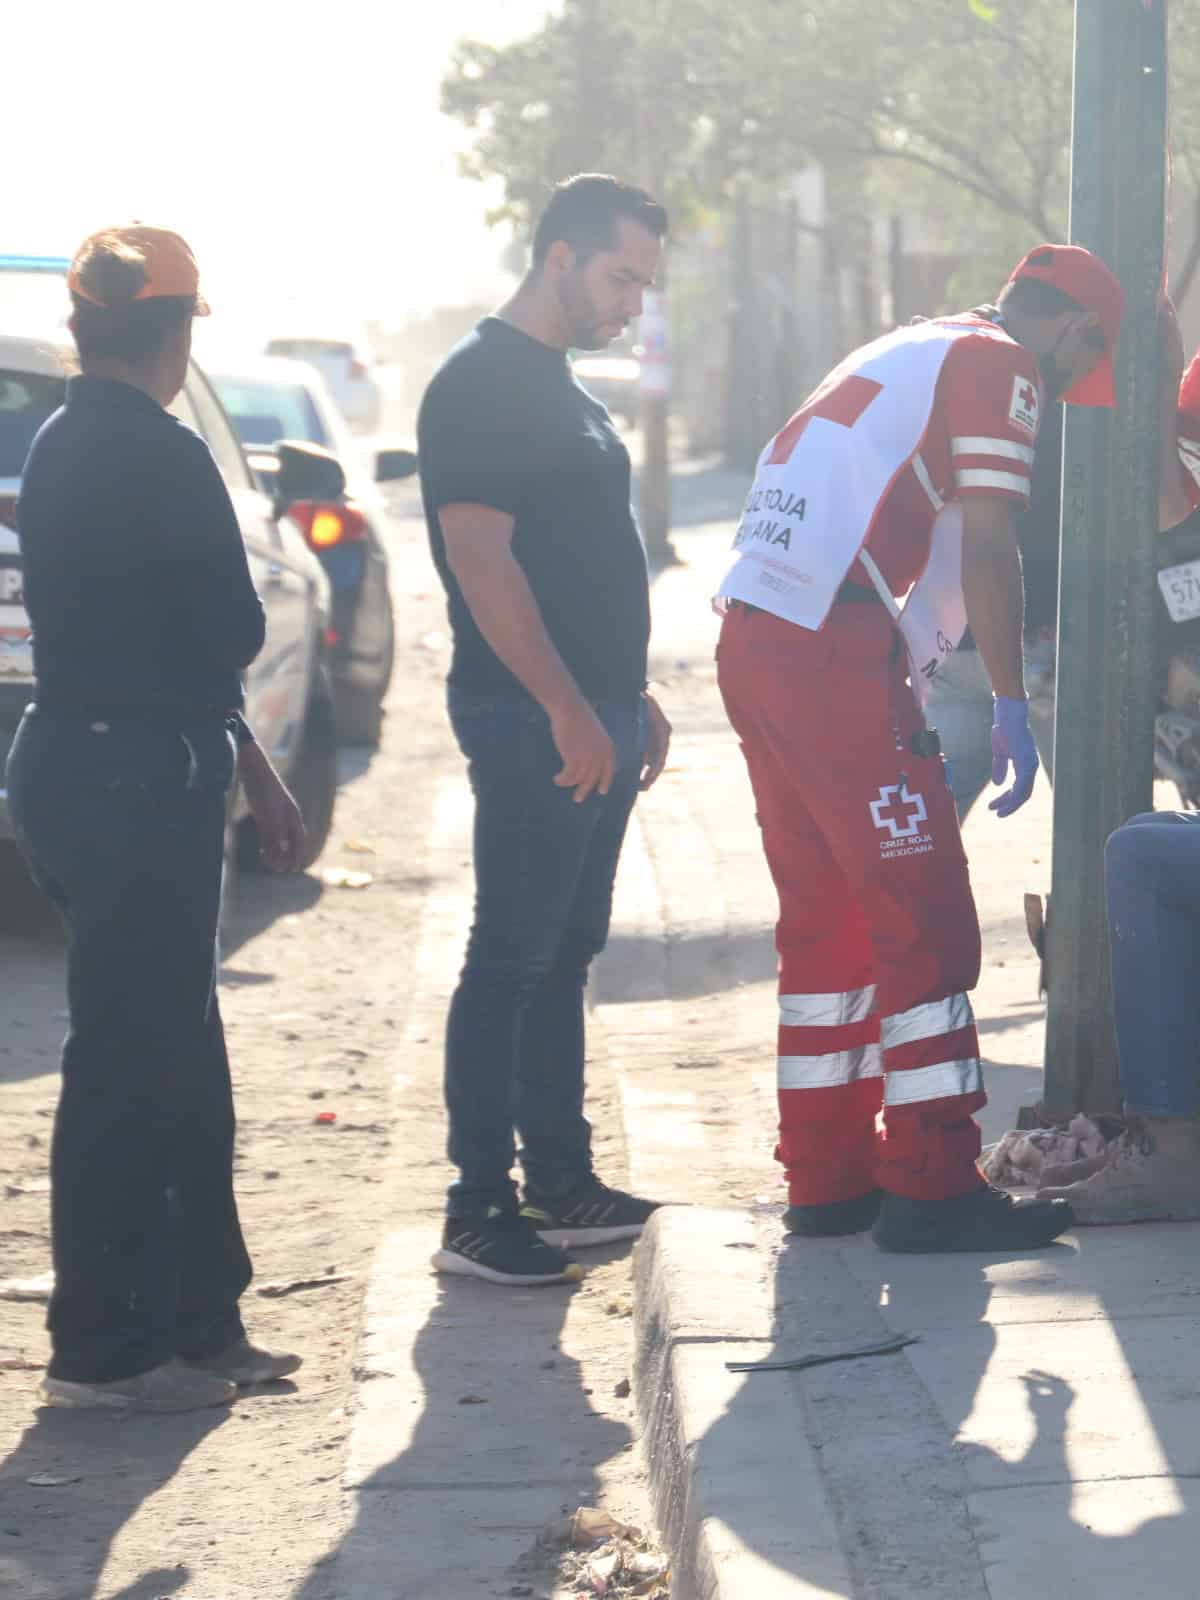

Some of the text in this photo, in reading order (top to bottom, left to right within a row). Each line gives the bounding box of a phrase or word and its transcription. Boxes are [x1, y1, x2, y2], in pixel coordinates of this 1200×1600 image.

[880, 833, 934, 849] CRUZ ROJA
[880, 844, 936, 859] MEXICANA
